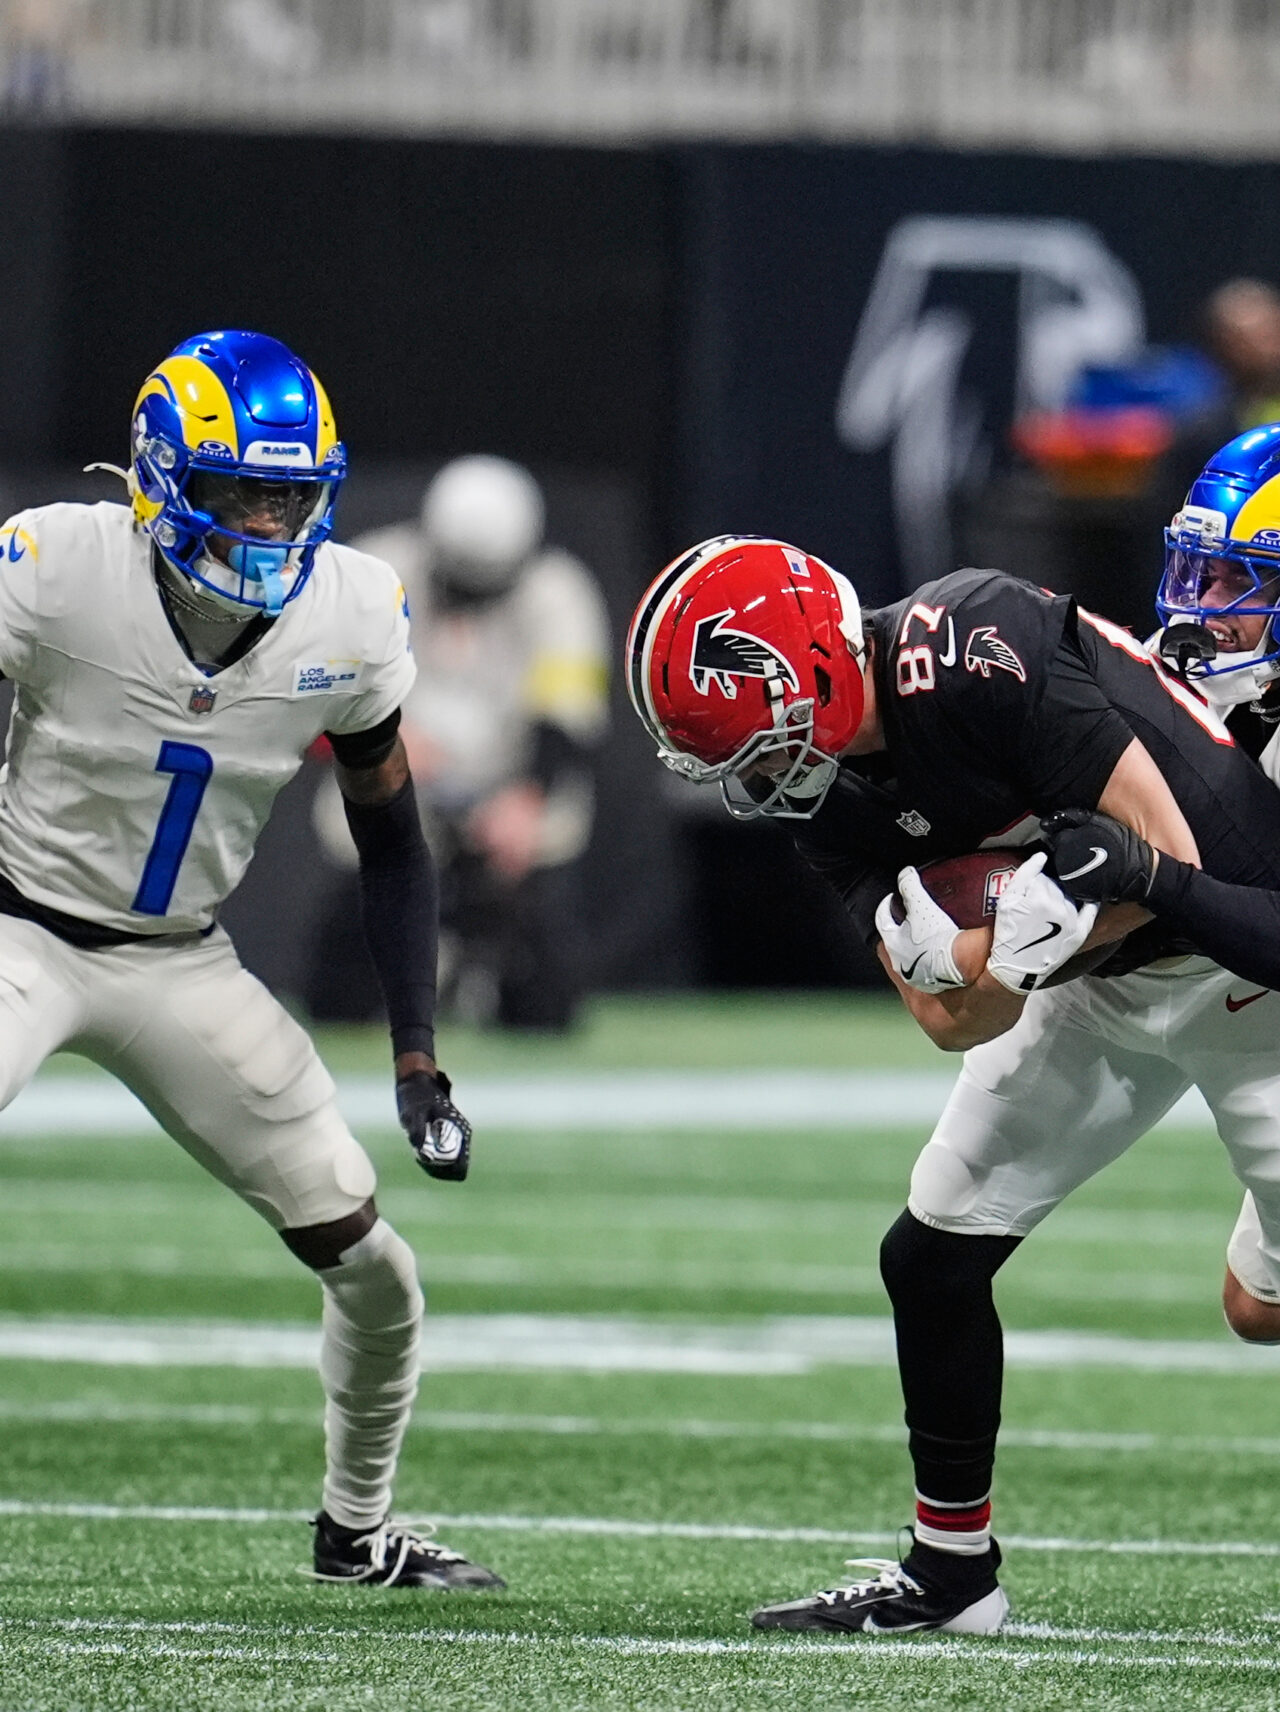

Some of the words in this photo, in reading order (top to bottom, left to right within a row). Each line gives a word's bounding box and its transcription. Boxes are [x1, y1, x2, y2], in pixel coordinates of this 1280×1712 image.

[261, 446, 301, 456] RAMS
[896, 601, 947, 697] 87
[299, 667, 325, 677] LOS
[298, 673, 357, 685] ANGELES
[297, 681, 333, 691] RAMS
[130, 739, 214, 917] 1
